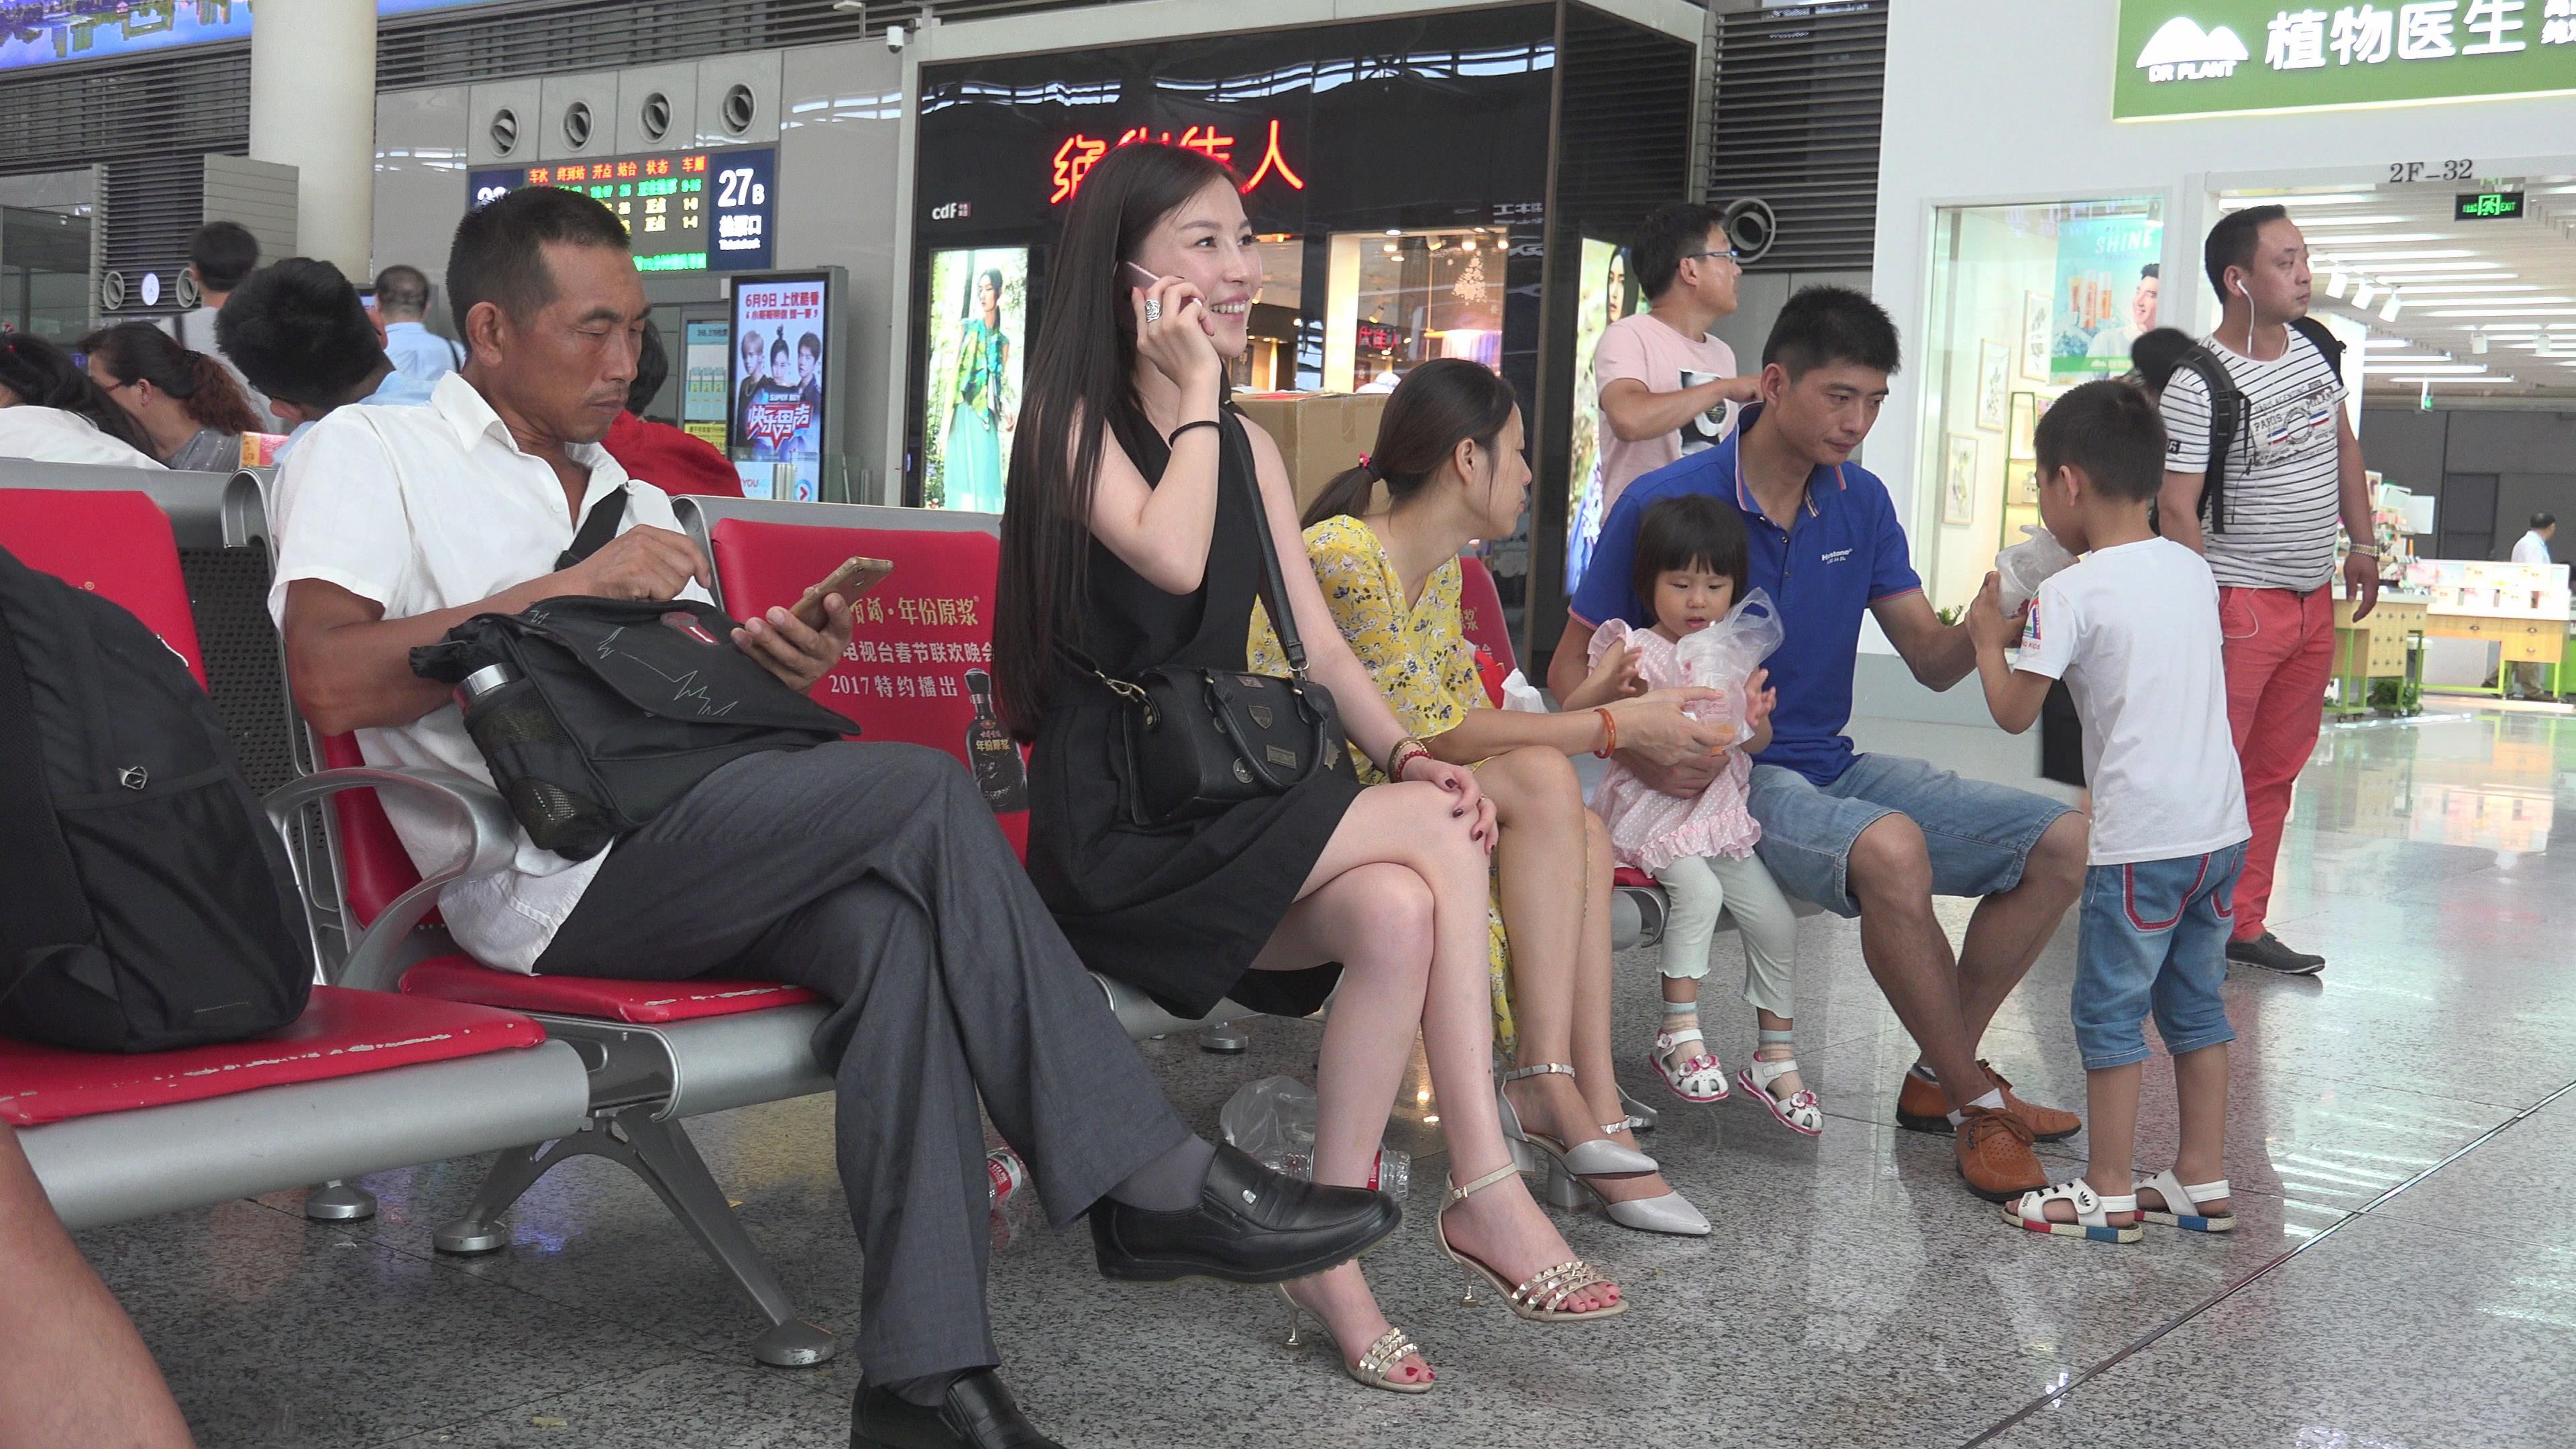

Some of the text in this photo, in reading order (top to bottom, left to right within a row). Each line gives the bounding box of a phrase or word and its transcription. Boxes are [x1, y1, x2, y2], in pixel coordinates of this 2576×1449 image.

[2265, 0, 2526, 70] 植物医生
[2149, 60, 2237, 83] DR PLANT
[2390, 158, 2473, 183] 2F-32
[932, 203, 957, 220] cdf
[745, 293, 777, 308] 6月9日
[2253, 413, 2283, 431] PARIS
[828, 674, 958, 698] 2017 特约播出
